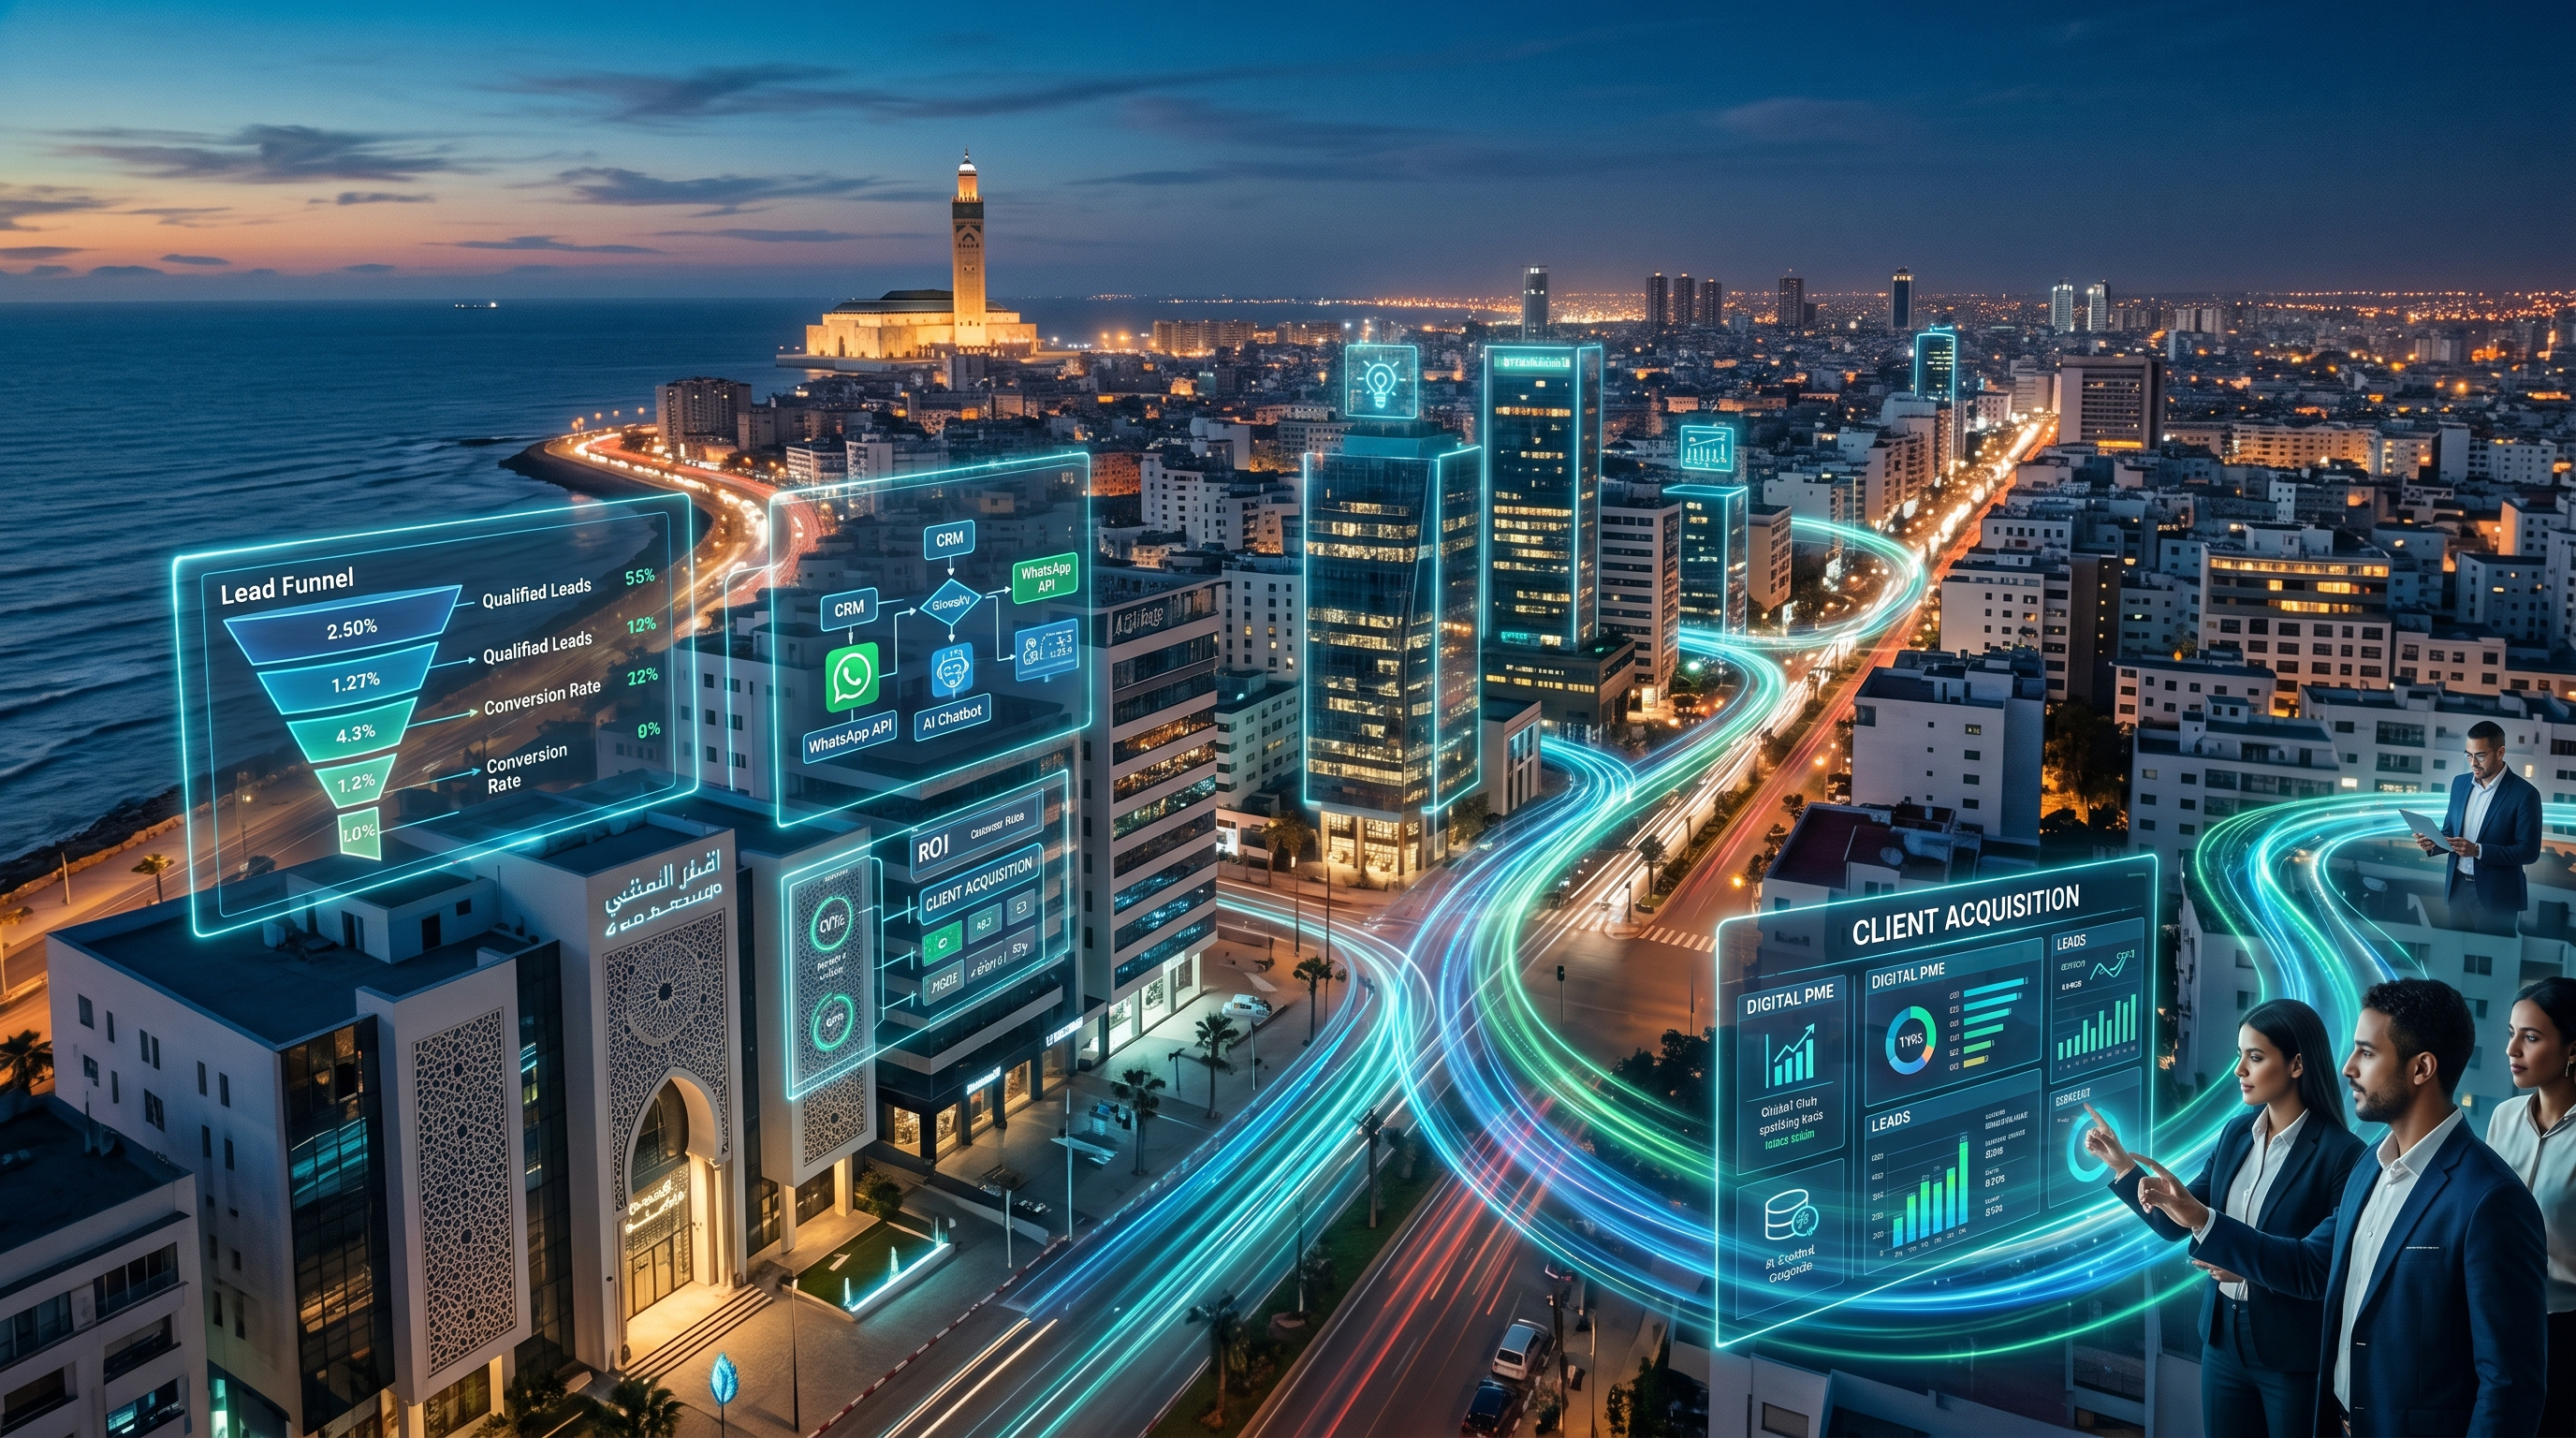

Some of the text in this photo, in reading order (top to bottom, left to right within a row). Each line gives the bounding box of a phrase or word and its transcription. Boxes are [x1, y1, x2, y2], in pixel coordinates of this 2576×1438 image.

[936, 530, 964, 548] CRM
[625, 567, 655, 586] 55%
[1021, 561, 1072, 580] WhatsApp
[221, 566, 354, 605] Lead Funnel
[482, 577, 592, 609] Qualified Leads
[1038, 578, 1055, 594] API
[834, 599, 865, 618] CRM
[327, 618, 378, 640] 2.50%
[626, 616, 657, 635] 12%
[552, 630, 593, 652] Leads
[331, 671, 381, 694] 1.27%
[484, 681, 601, 716] Conversion Rate
[923, 704, 982, 730] AI Chatbot
[335, 724, 376, 743] 4.3%
[809, 718, 892, 754] WhatsApp API
[486, 745, 567, 774] Conversion
[337, 773, 375, 793] 1.2%
[488, 775, 521, 795] Rate
[918, 833, 948, 863] ROI
[926, 856, 1032, 912] CLIENT ACQUISITION
[1852, 884, 2080, 946] CLIENT ACQUISITION
[2057, 933, 2086, 951] LEADS
[1872, 961, 1945, 990] DIGITAL PME
[1747, 983, 1835, 1015] DIGITAL PME
[1872, 1110, 1910, 1133] LEADS
